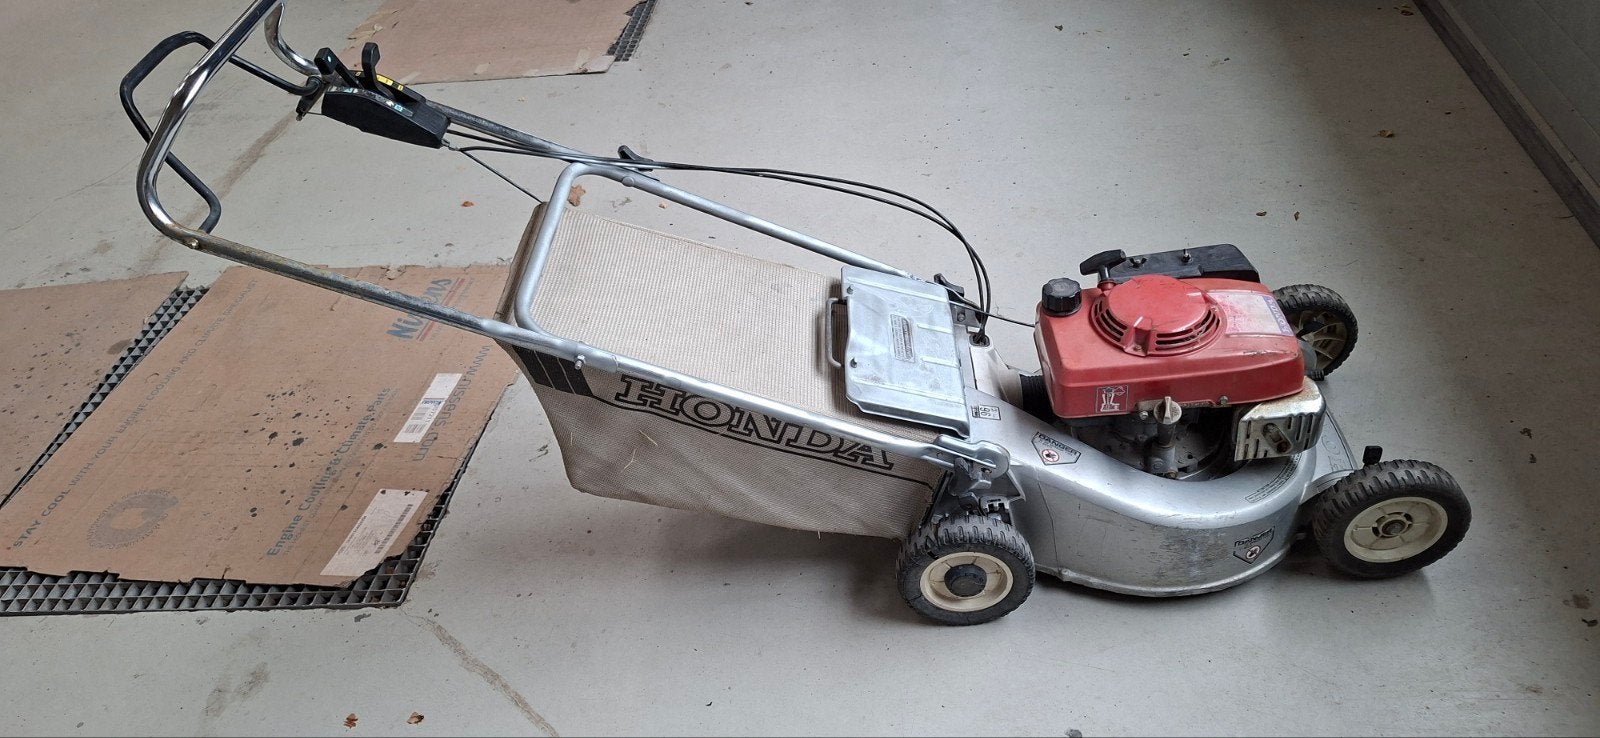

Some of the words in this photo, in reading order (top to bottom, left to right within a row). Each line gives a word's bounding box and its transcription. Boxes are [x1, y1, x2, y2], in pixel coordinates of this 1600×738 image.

[614, 374, 894, 470] HONDA
[1039, 434, 1077, 455] DANGER
[267, 514, 304, 557] Engine
[299, 465, 338, 512] Cooling
[336, 413, 373, 454] Climate
[367, 387, 392, 412] Parts
[13, 519, 42, 547] STAY
[41, 488, 71, 517] COOL
